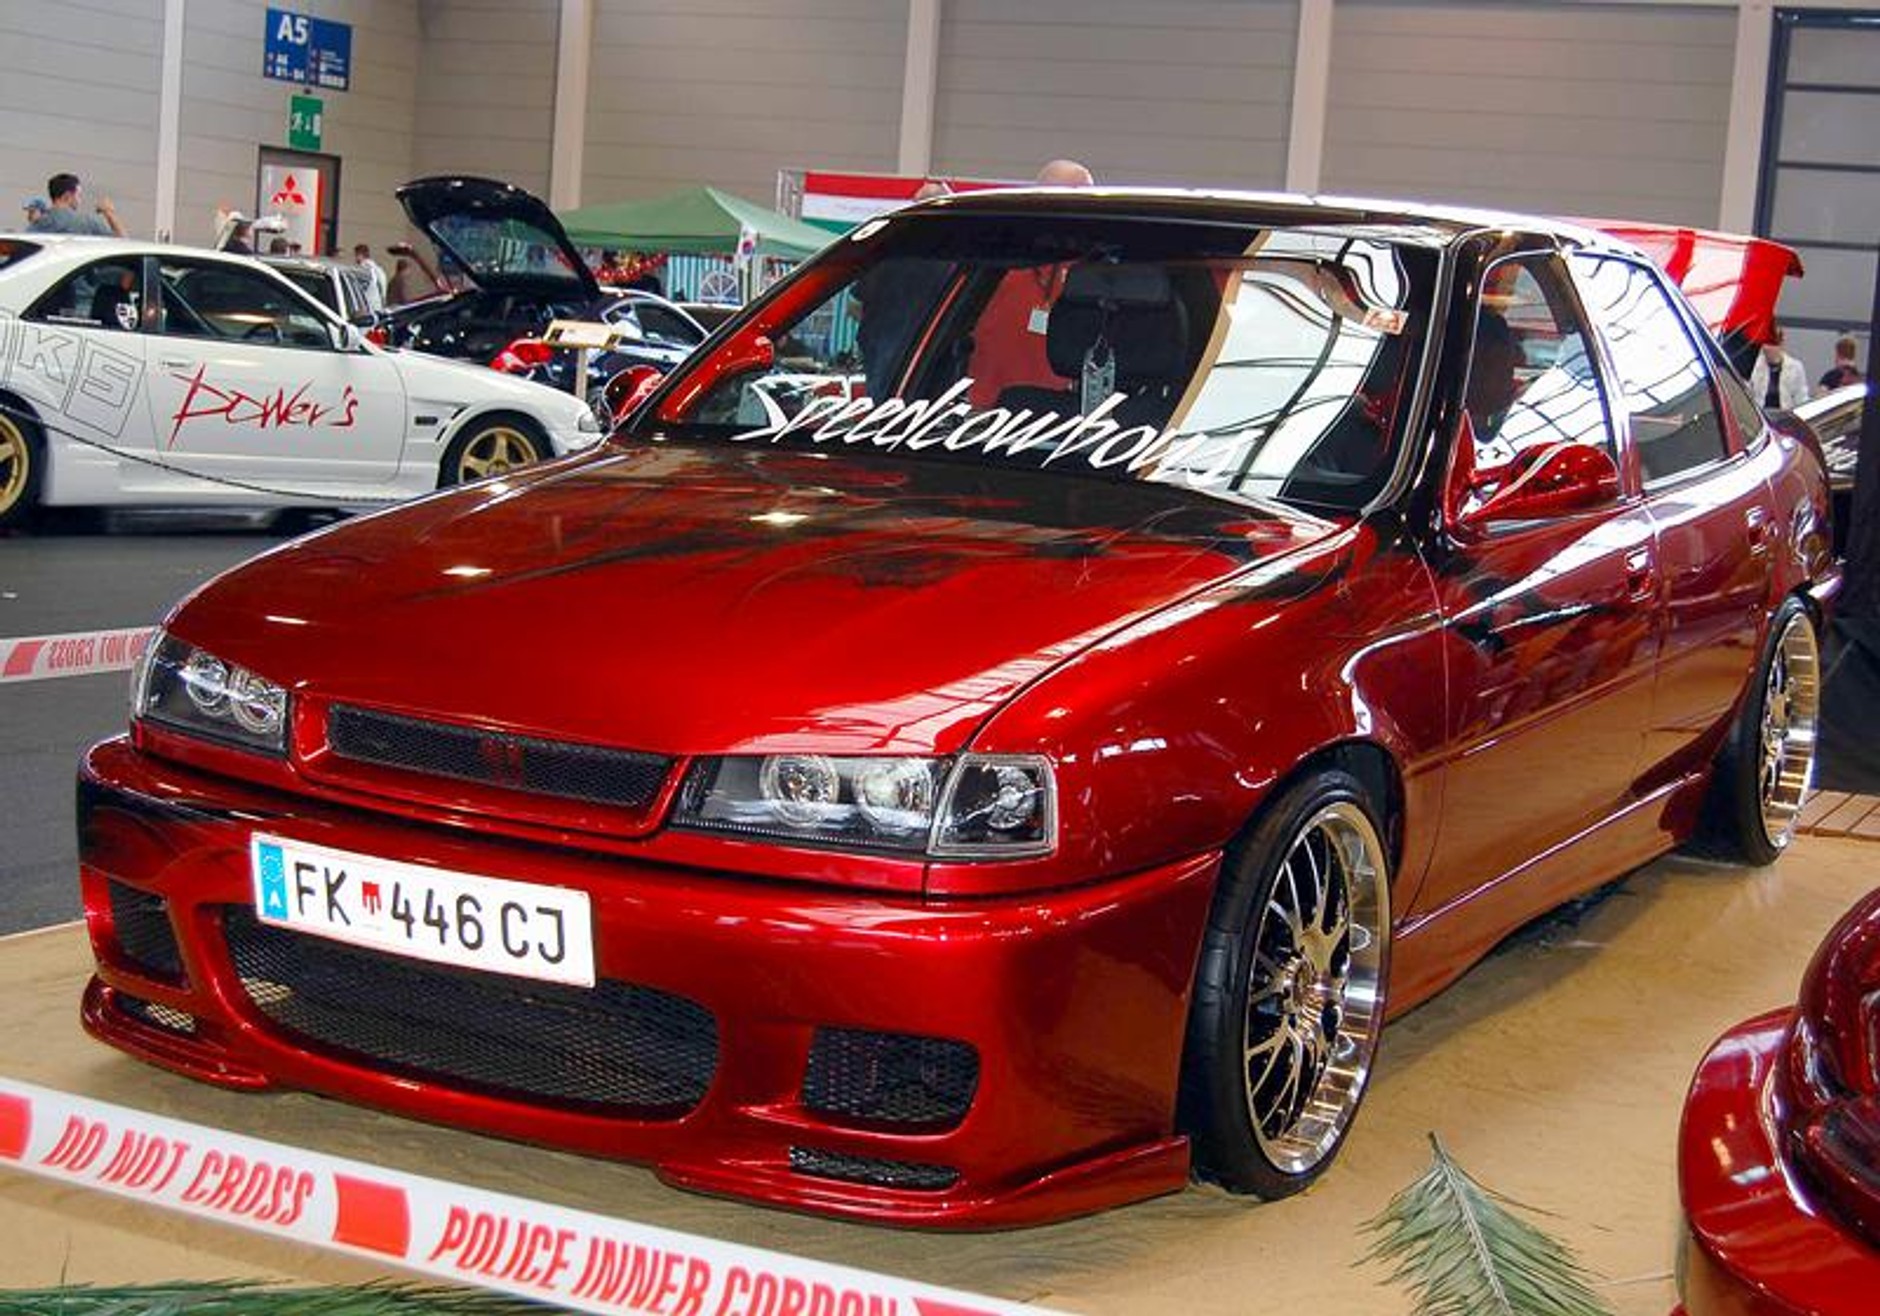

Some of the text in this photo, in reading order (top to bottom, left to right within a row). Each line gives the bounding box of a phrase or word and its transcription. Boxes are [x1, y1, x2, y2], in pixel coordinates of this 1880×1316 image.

[277, 14, 309, 46] A5
[294, 861, 567, 965] FK 446 CJ
[40, 1114, 316, 1226] DO NOT CROSS
[427, 1204, 577, 1290] POLICE
[569, 1236, 712, 1316] INNER
